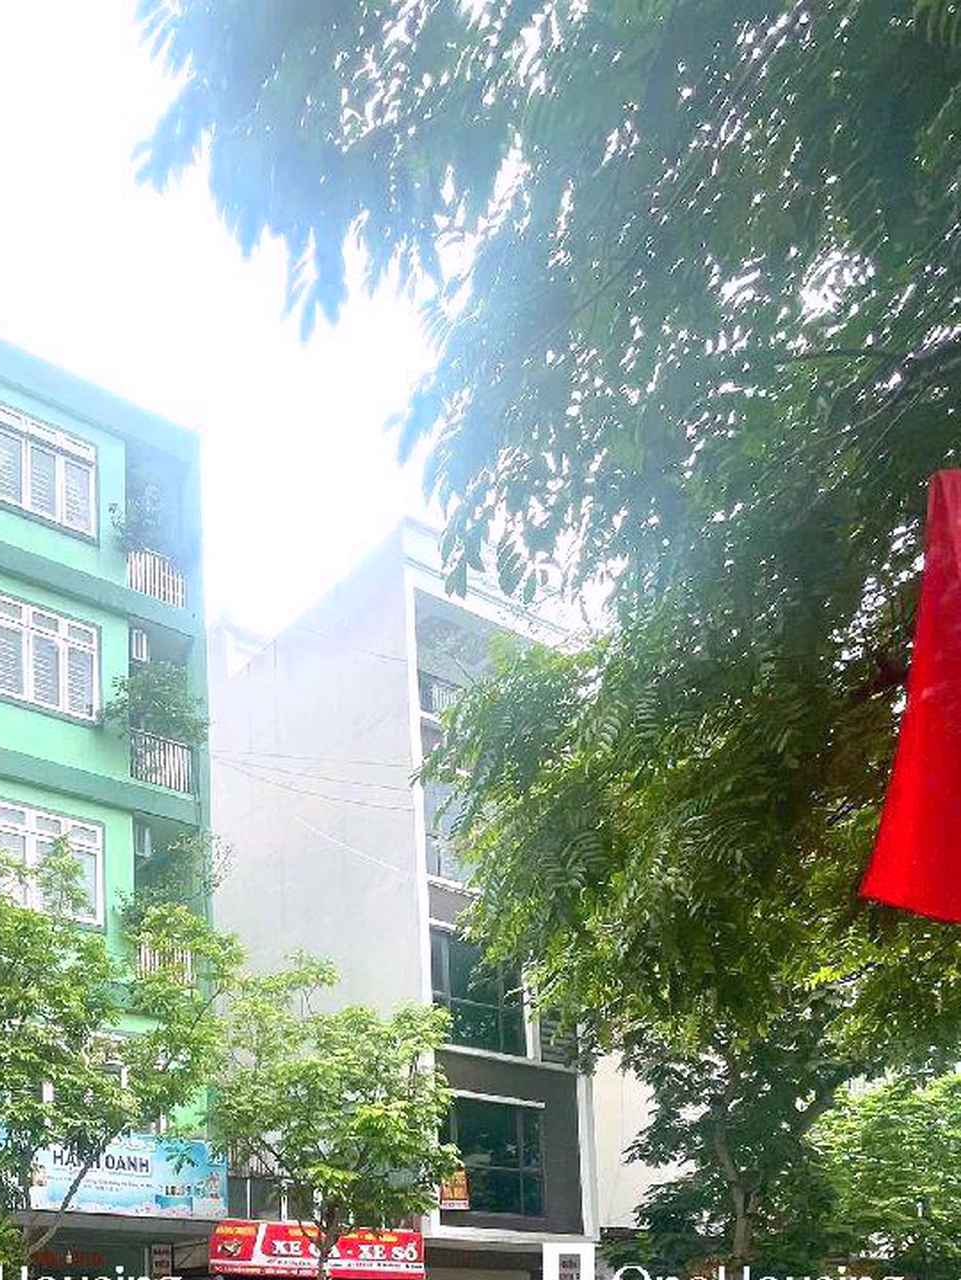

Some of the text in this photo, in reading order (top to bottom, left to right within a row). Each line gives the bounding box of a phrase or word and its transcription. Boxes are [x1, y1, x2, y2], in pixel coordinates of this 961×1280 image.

[105, 1154, 149, 1173] OANH
[272, 1240, 302, 1254] XE
[358, 1244, 387, 1260] XE
[391, 1241, 419, 1261] SỐ
